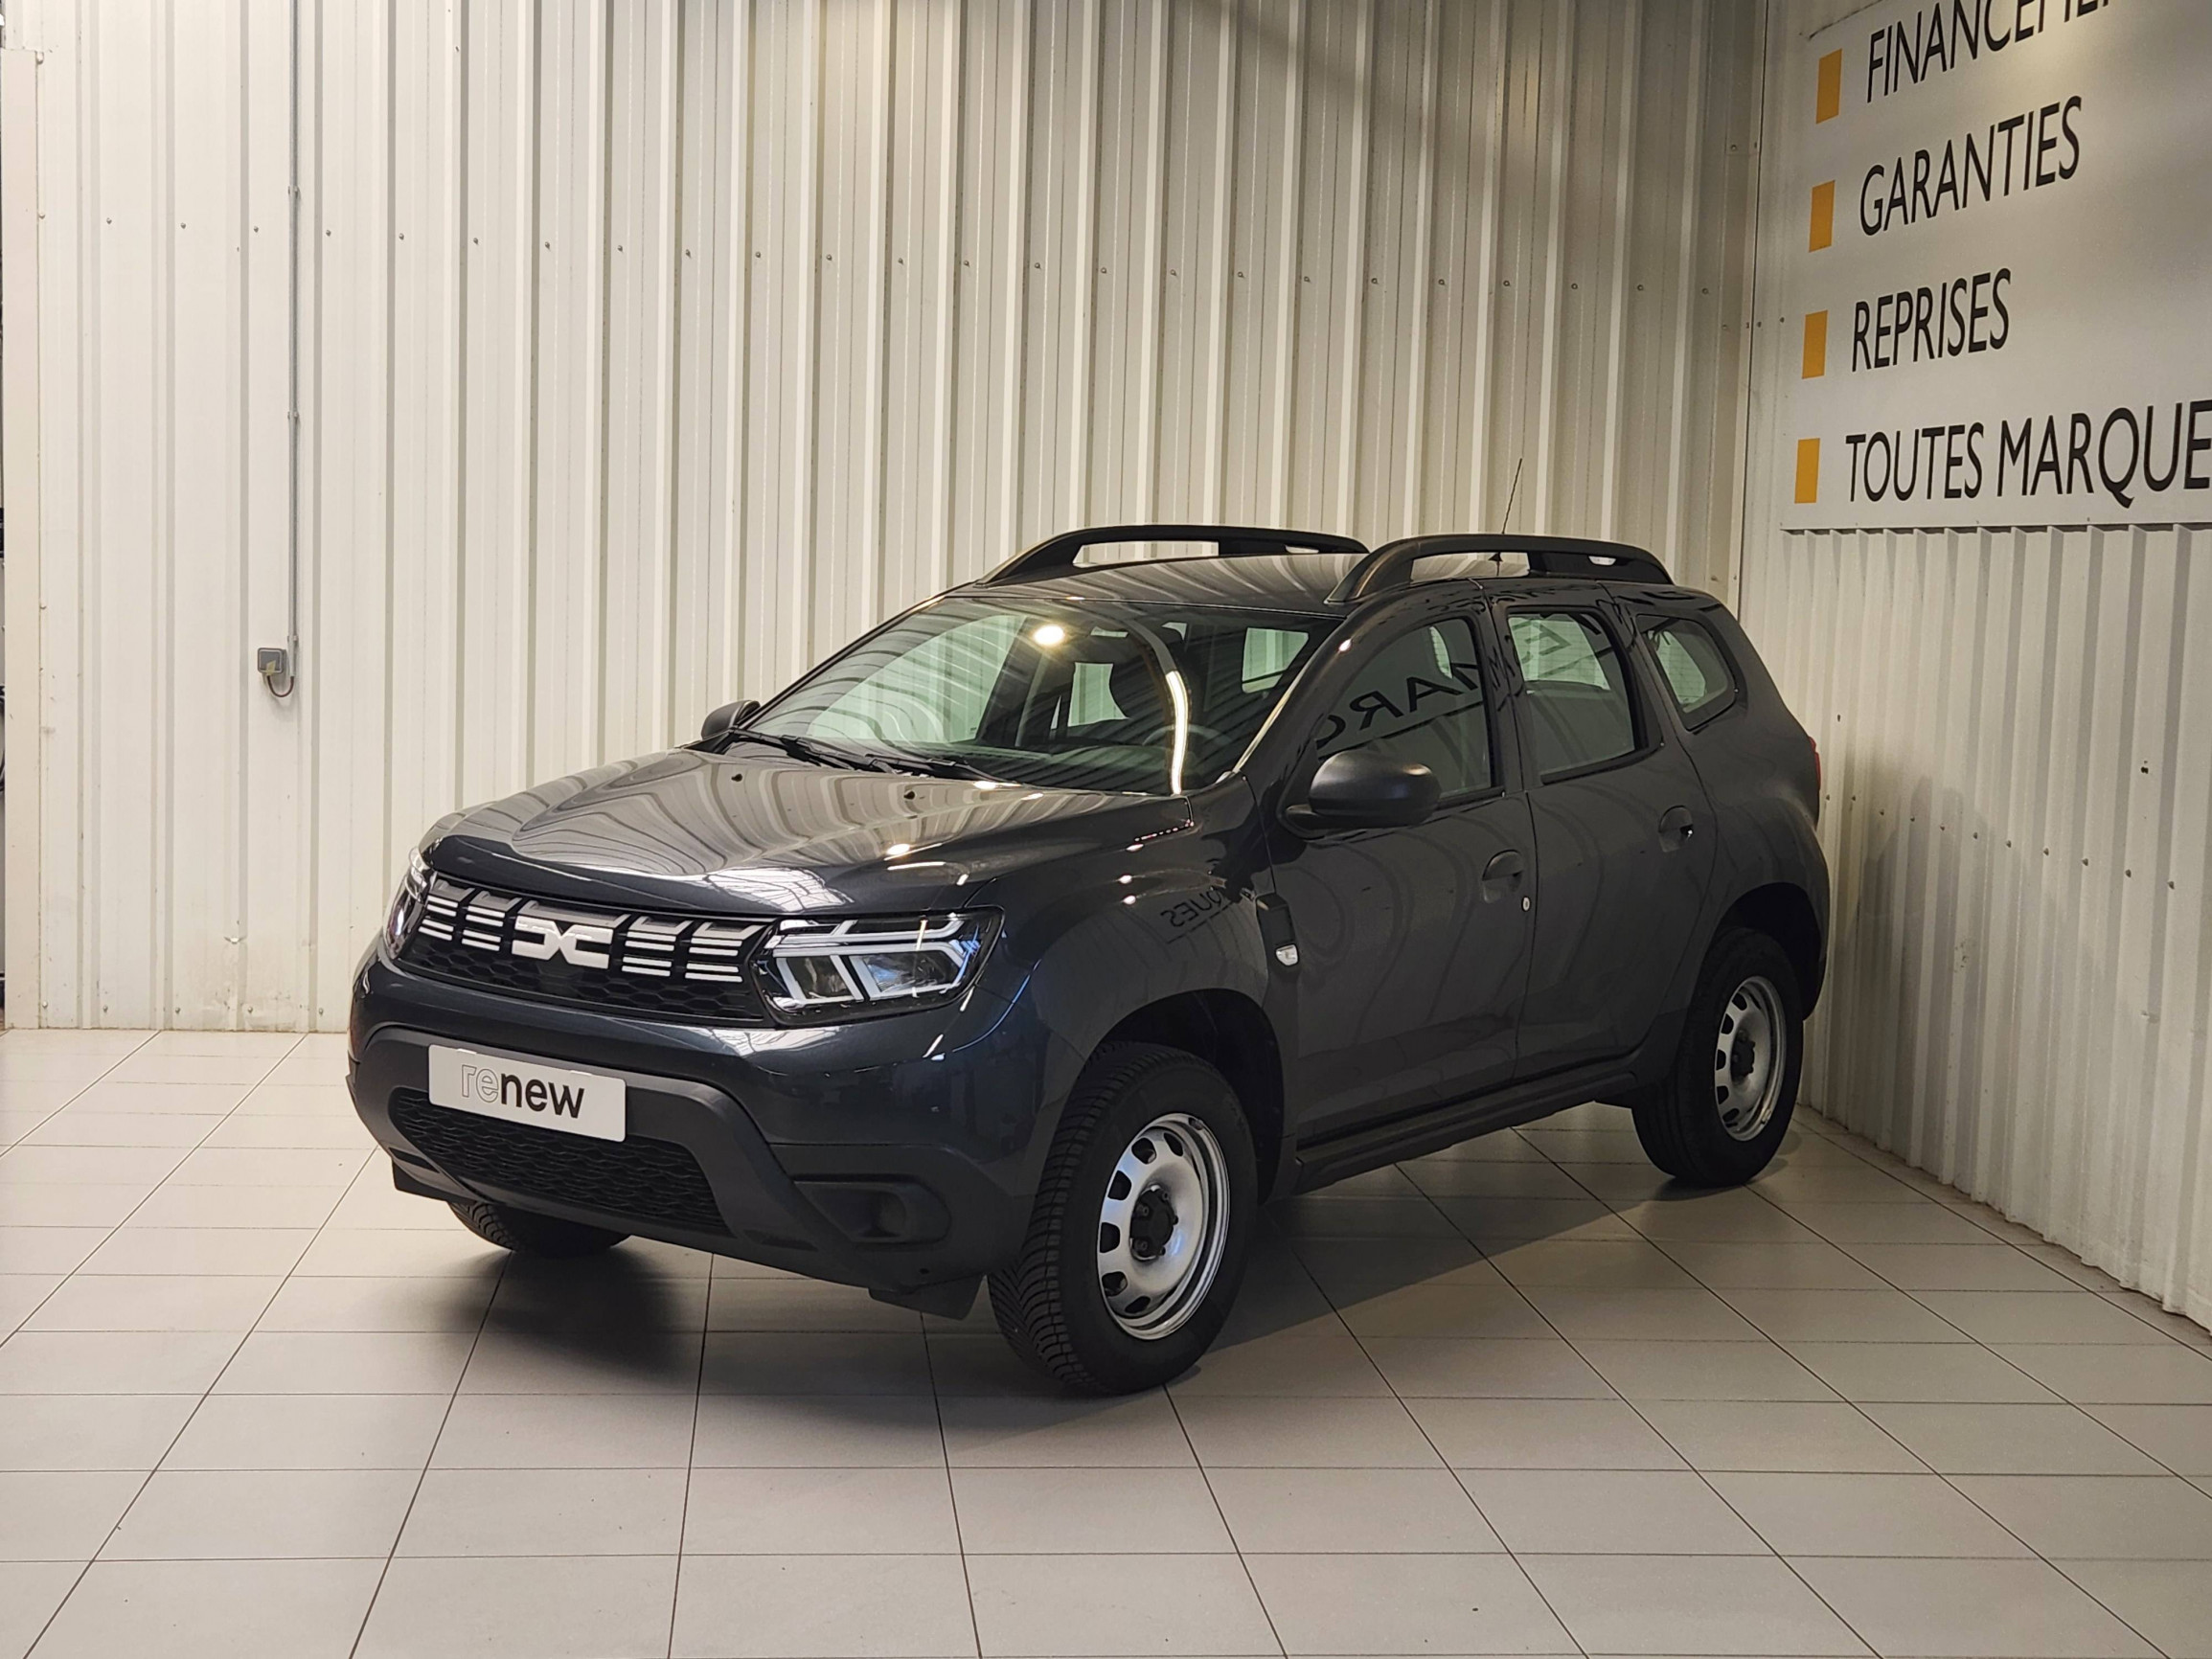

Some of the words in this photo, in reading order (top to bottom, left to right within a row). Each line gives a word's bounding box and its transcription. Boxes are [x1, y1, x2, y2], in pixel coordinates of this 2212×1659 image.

[1866, 0, 2109, 103] FINANCE
[1859, 95, 2083, 237] GARANTIES
[1852, 267, 2012, 373] REPRISES
[1845, 421, 1985, 503] TOUTES
[1996, 398, 2212, 509] MARQUE
[461, 1063, 585, 1119] renew
